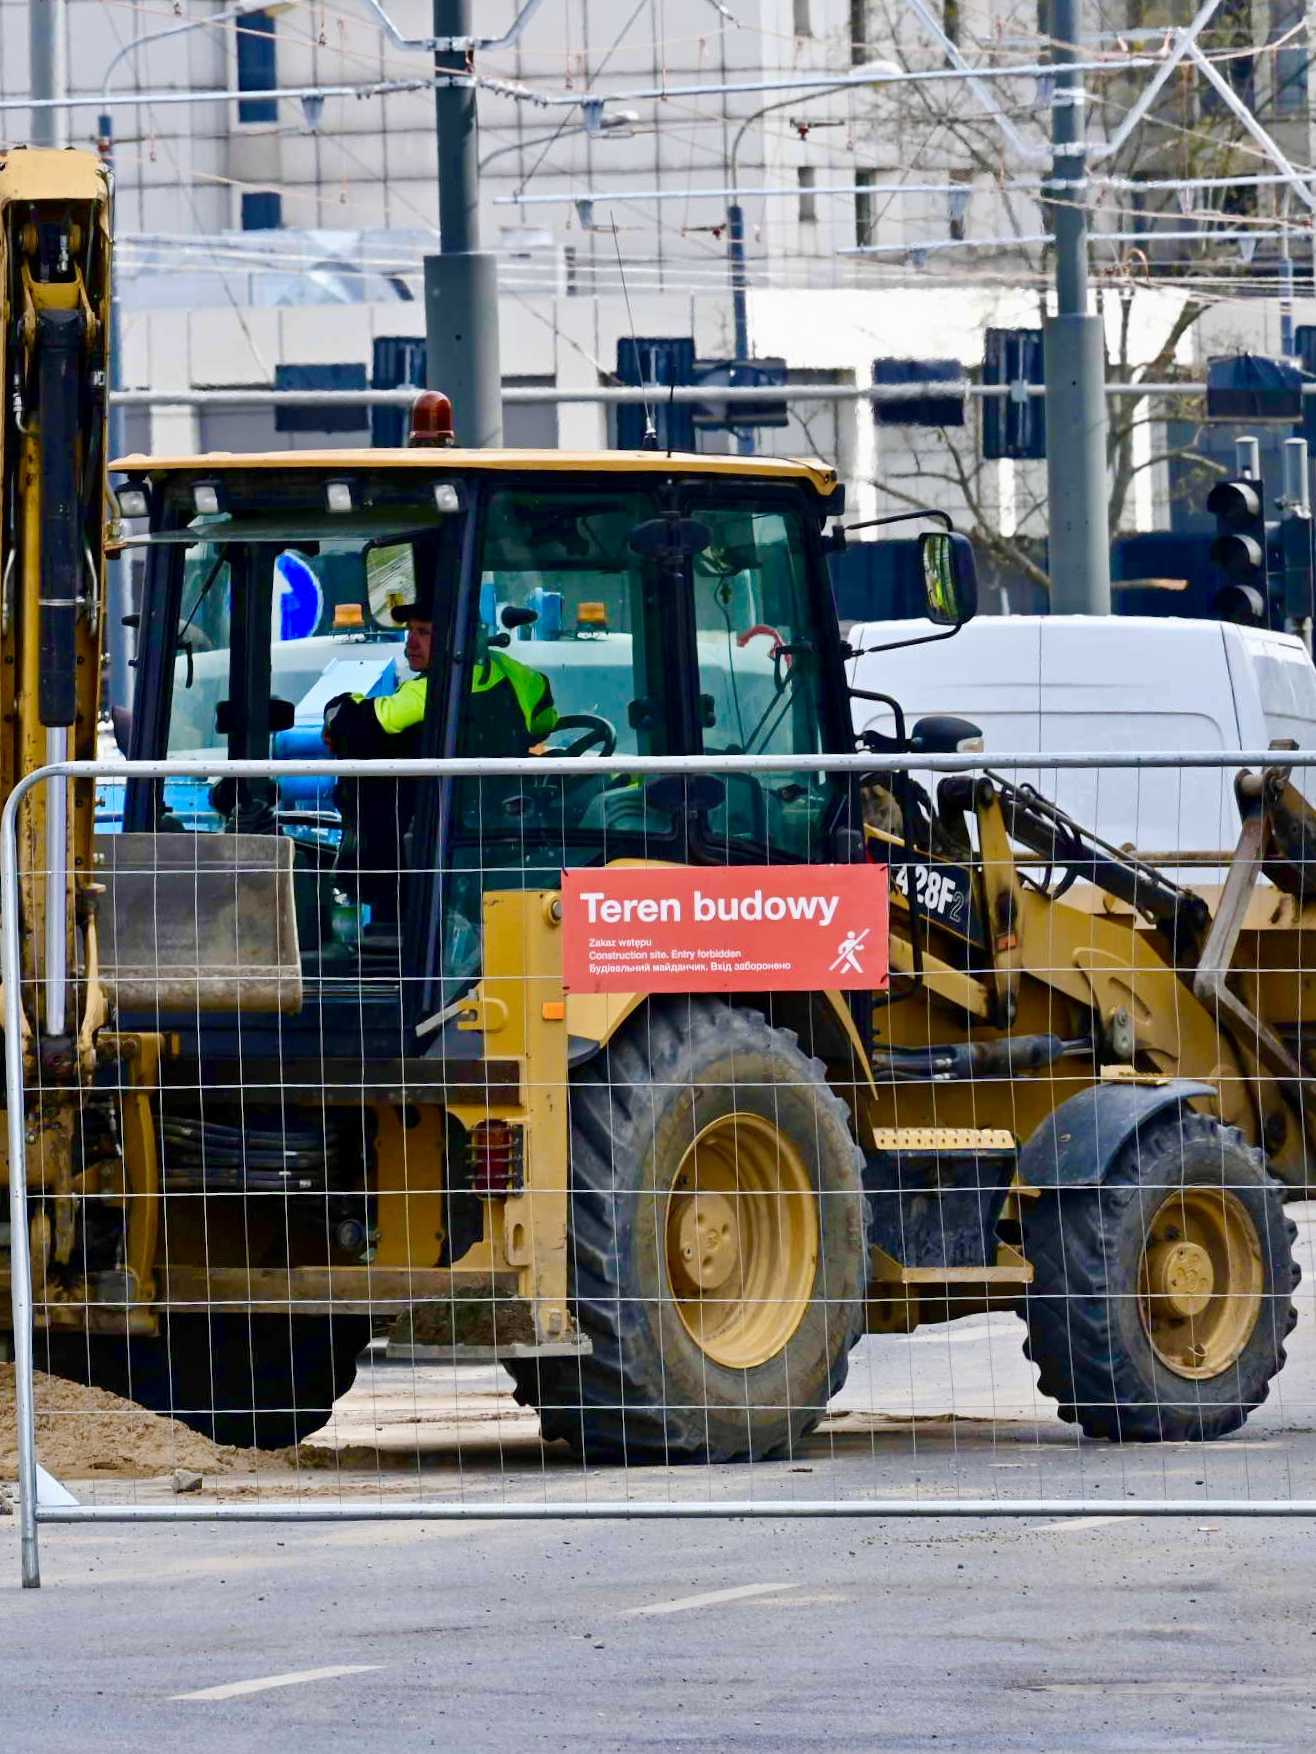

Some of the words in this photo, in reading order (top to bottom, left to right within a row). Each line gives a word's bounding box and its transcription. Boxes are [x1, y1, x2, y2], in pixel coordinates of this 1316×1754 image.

[580, 892, 681, 923] Teren
[694, 890, 840, 927] budowy
[588, 938, 616, 948] Zakaz
[618, 938, 652, 949] wstępu
[588, 950, 648, 960] Construction
[650, 950, 669, 960] site.
[671, 949, 695, 961] Entry
[697, 948, 742, 959] forbidden
[589, 962, 651, 975] Будівельний
[710, 961, 733, 972] Вхід
[734, 960, 792, 972] заборонено
